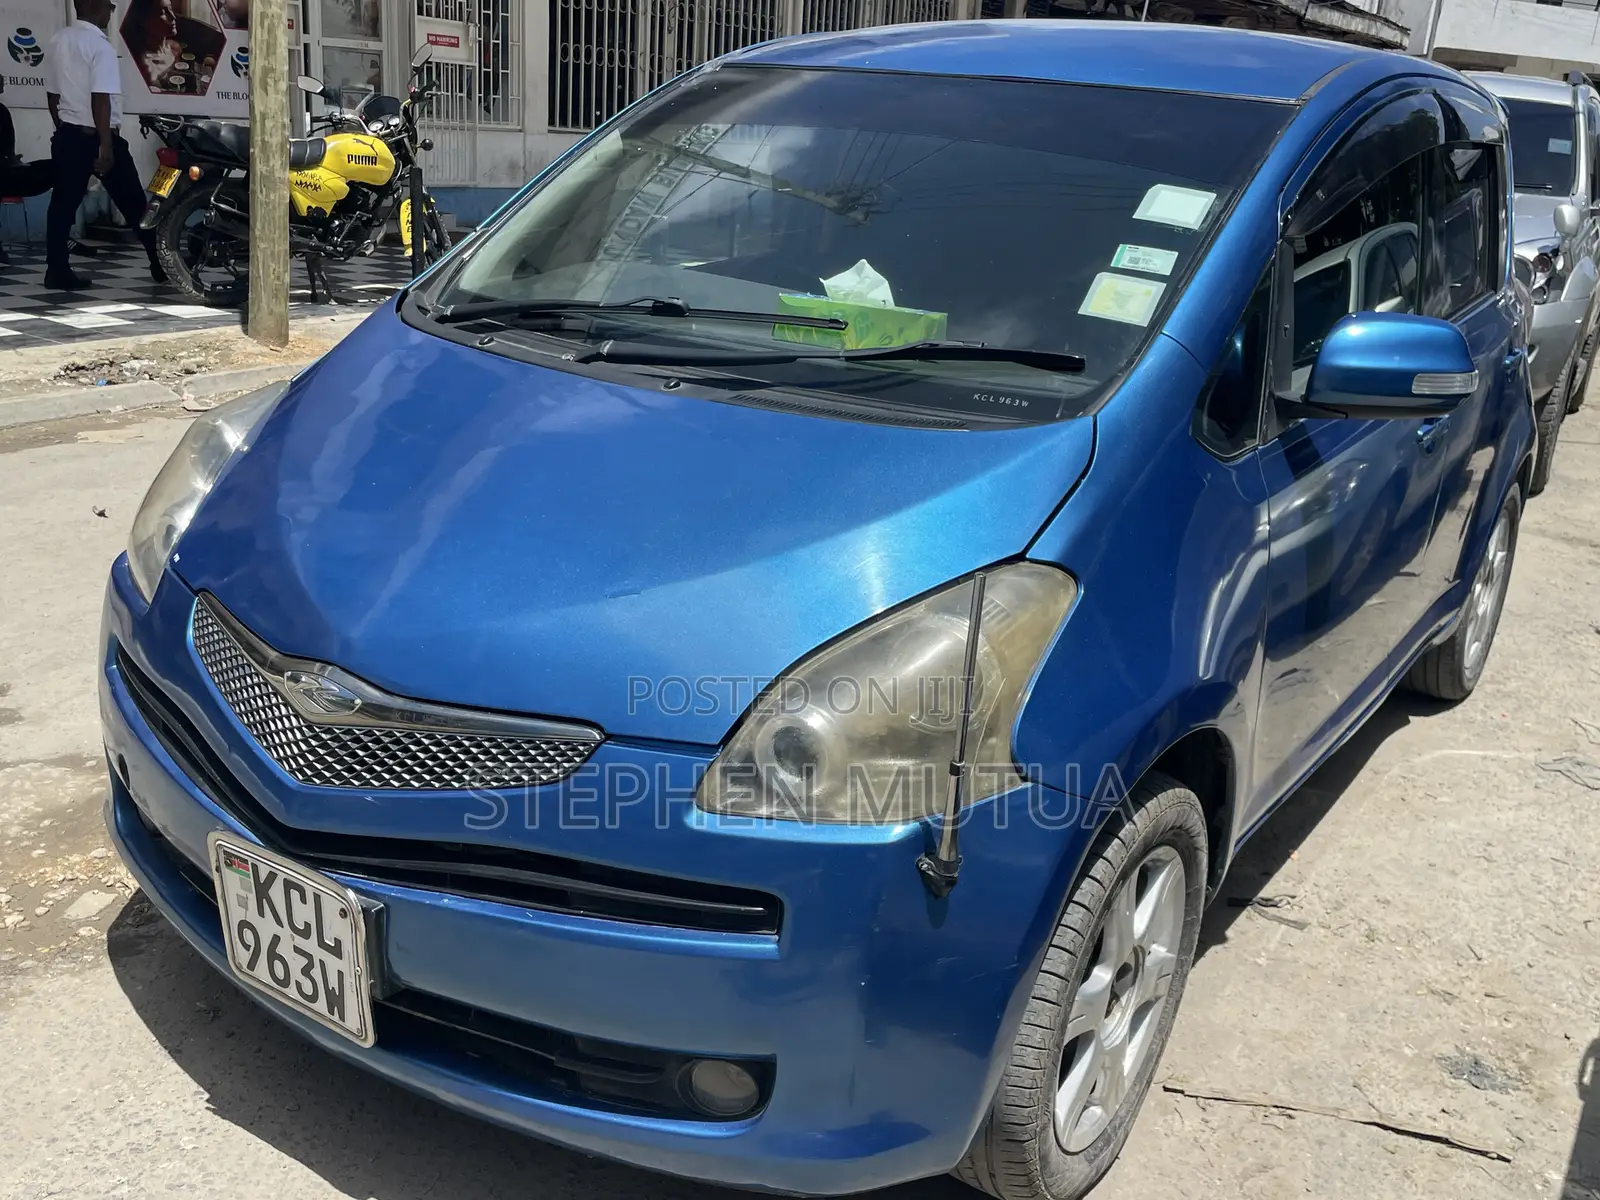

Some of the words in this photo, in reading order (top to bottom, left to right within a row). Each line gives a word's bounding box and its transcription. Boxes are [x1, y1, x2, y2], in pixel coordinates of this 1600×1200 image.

[9, 76, 45, 86] BLOOM
[216, 91, 231, 100] THE
[347, 153, 377, 166] PUMA
[973, 393, 995, 402] KCL
[998, 396, 1029, 407] 963W
[251, 862, 342, 960] KCL
[237, 919, 345, 1022] 963W
